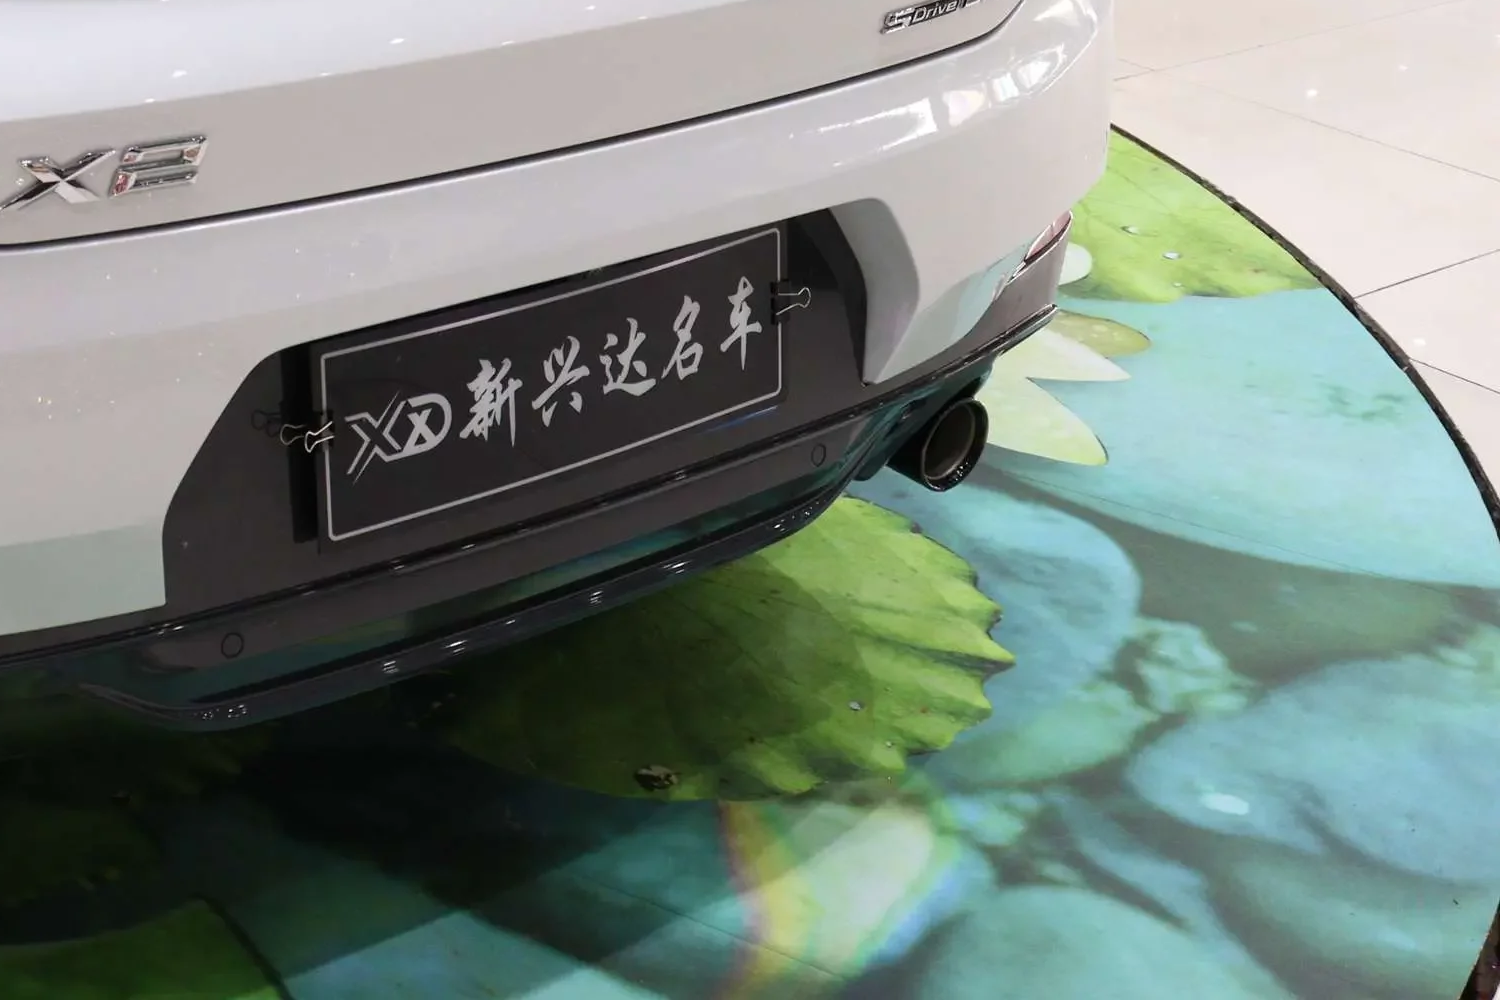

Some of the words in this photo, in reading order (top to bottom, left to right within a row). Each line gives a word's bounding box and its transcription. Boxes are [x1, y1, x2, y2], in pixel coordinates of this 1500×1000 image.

[459, 276, 762, 447] 新兴达名车
